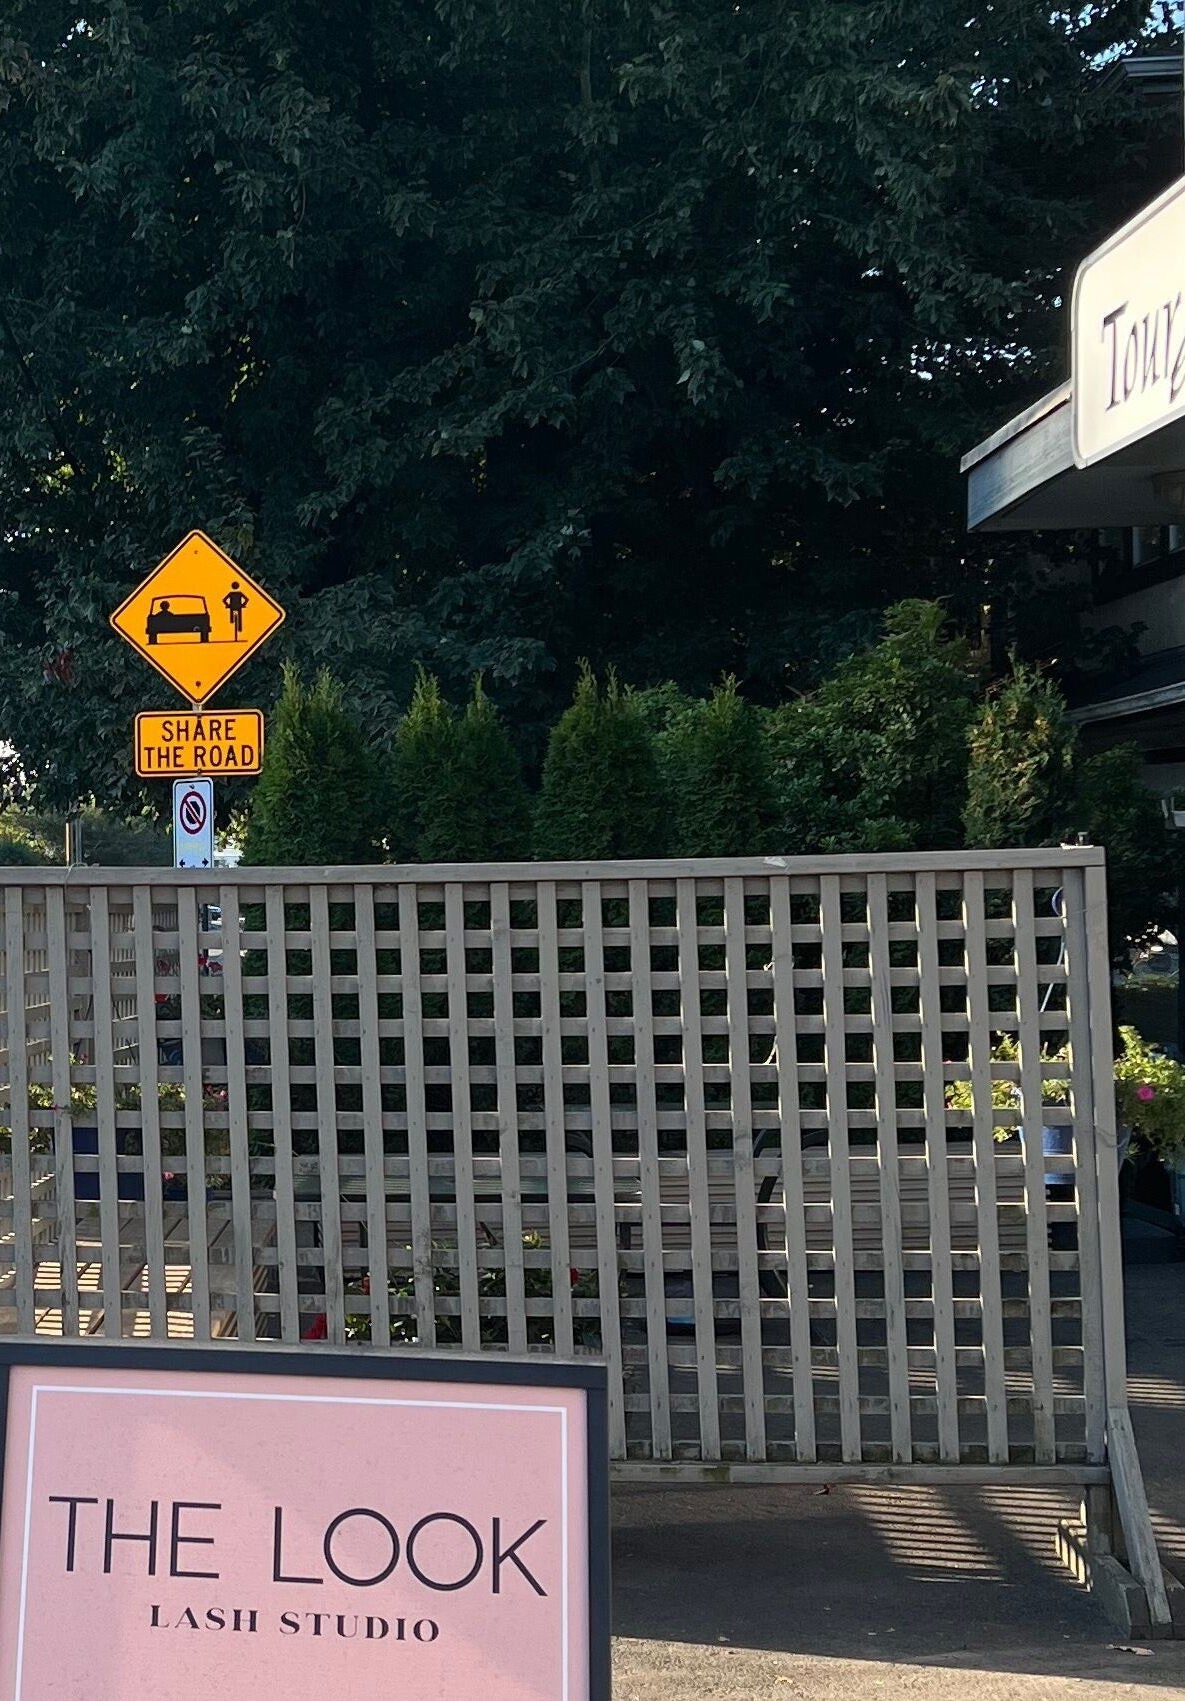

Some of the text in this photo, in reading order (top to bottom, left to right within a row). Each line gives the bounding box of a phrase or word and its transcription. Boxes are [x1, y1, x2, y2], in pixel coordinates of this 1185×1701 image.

[161, 718, 236, 742] SHARE
[144, 744, 254, 768] THE ROAD
[48, 1495, 548, 1597] THE LOOK
[150, 1604, 440, 1642] LASH STUDIO
